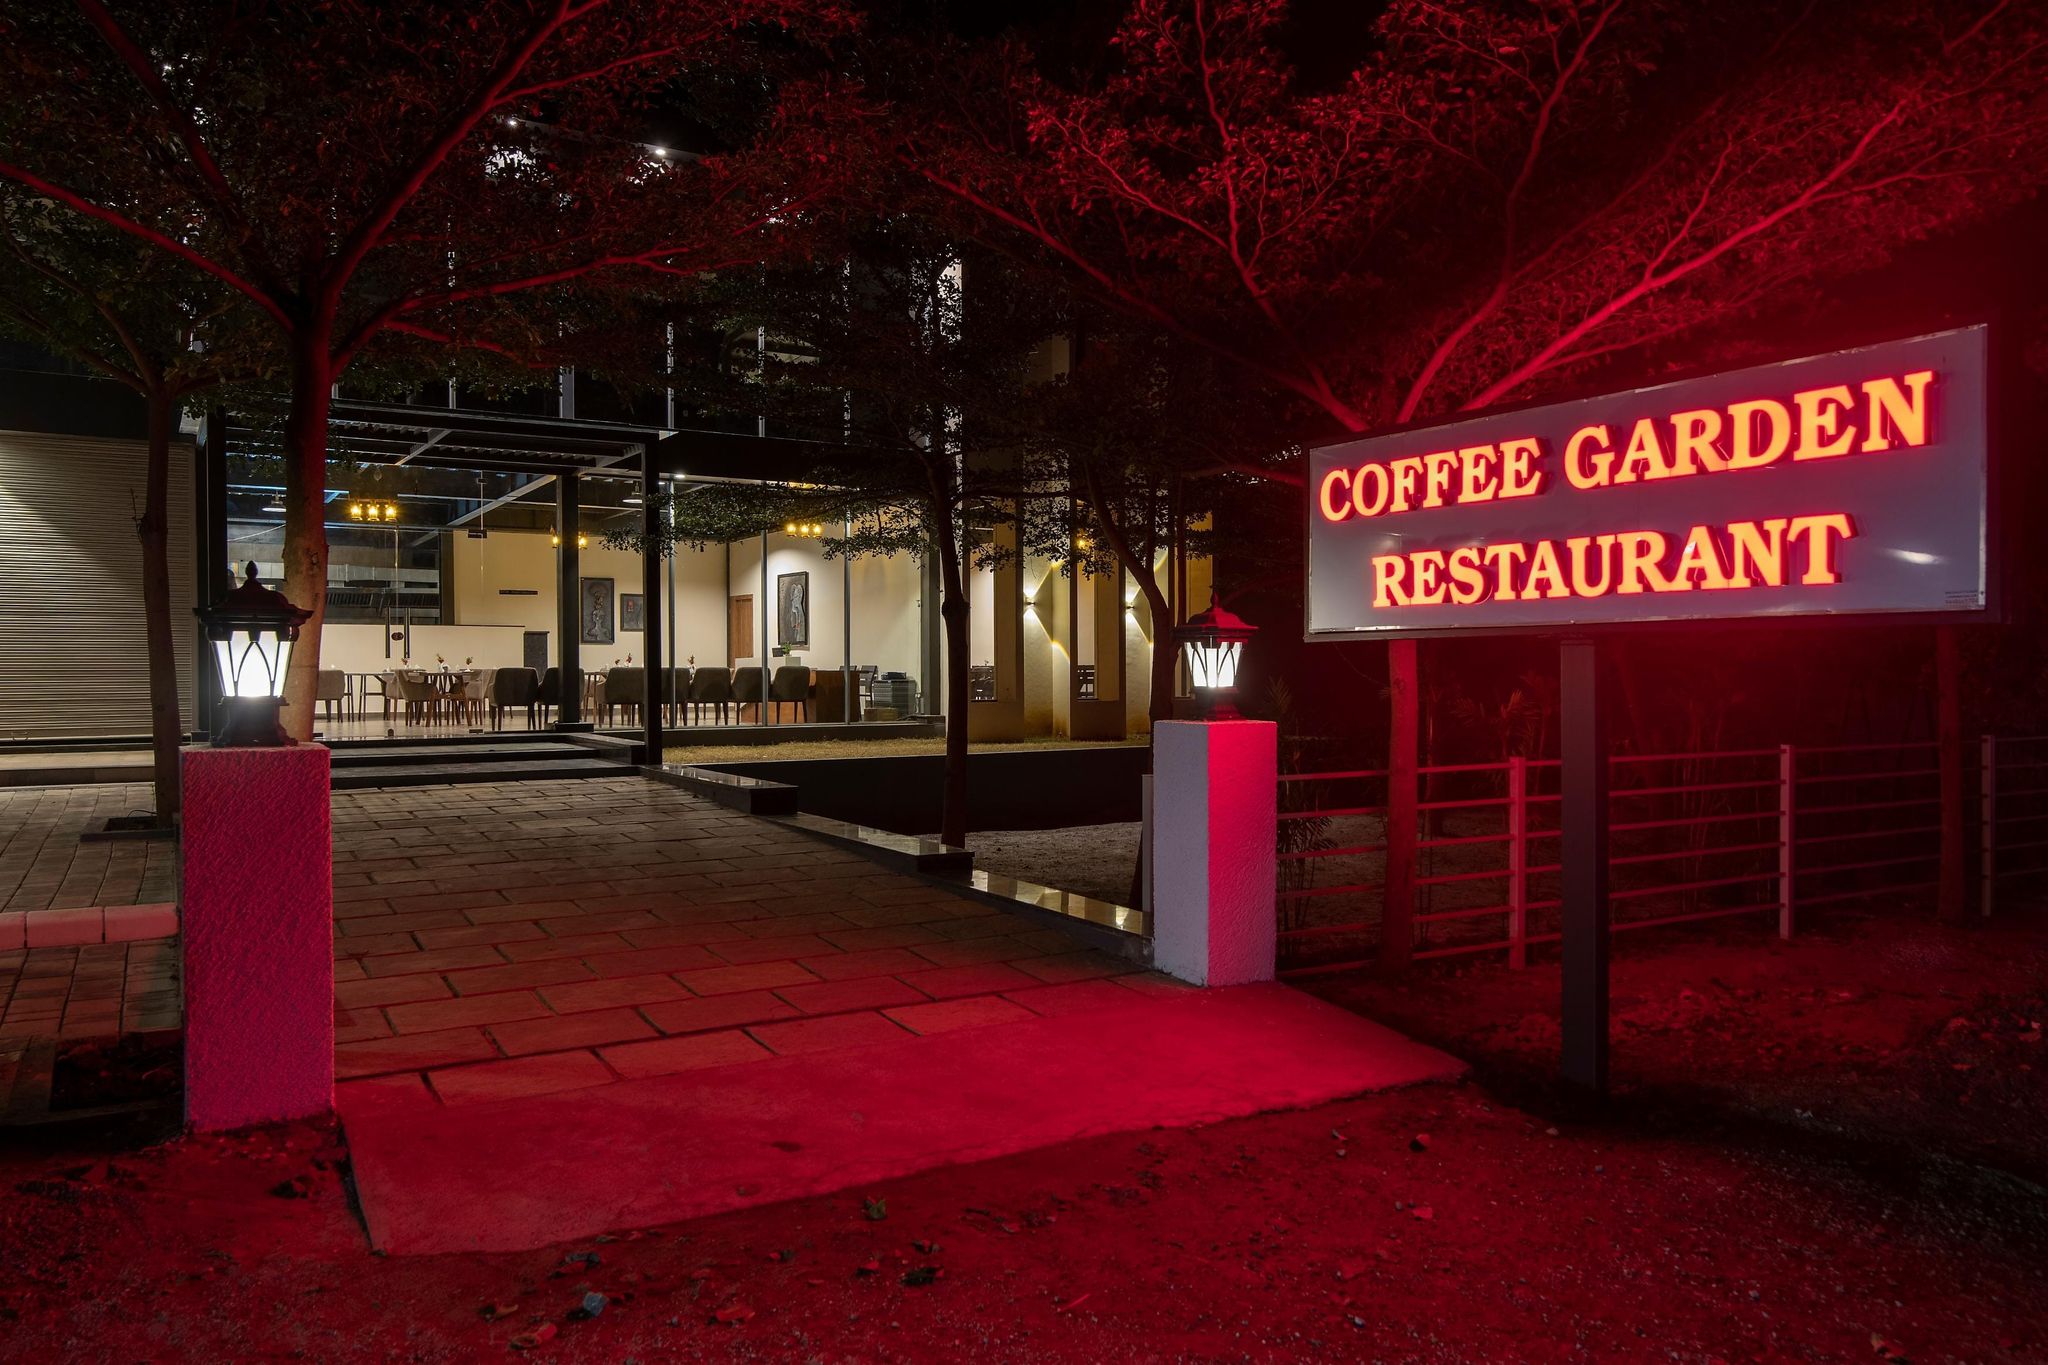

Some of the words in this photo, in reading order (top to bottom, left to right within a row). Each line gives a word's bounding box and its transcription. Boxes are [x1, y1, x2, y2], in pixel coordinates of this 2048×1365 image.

[1319, 436, 1543, 522] COFFEE
[1563, 370, 1933, 489] GARDEN
[1371, 513, 1852, 609] RESTAURANT
